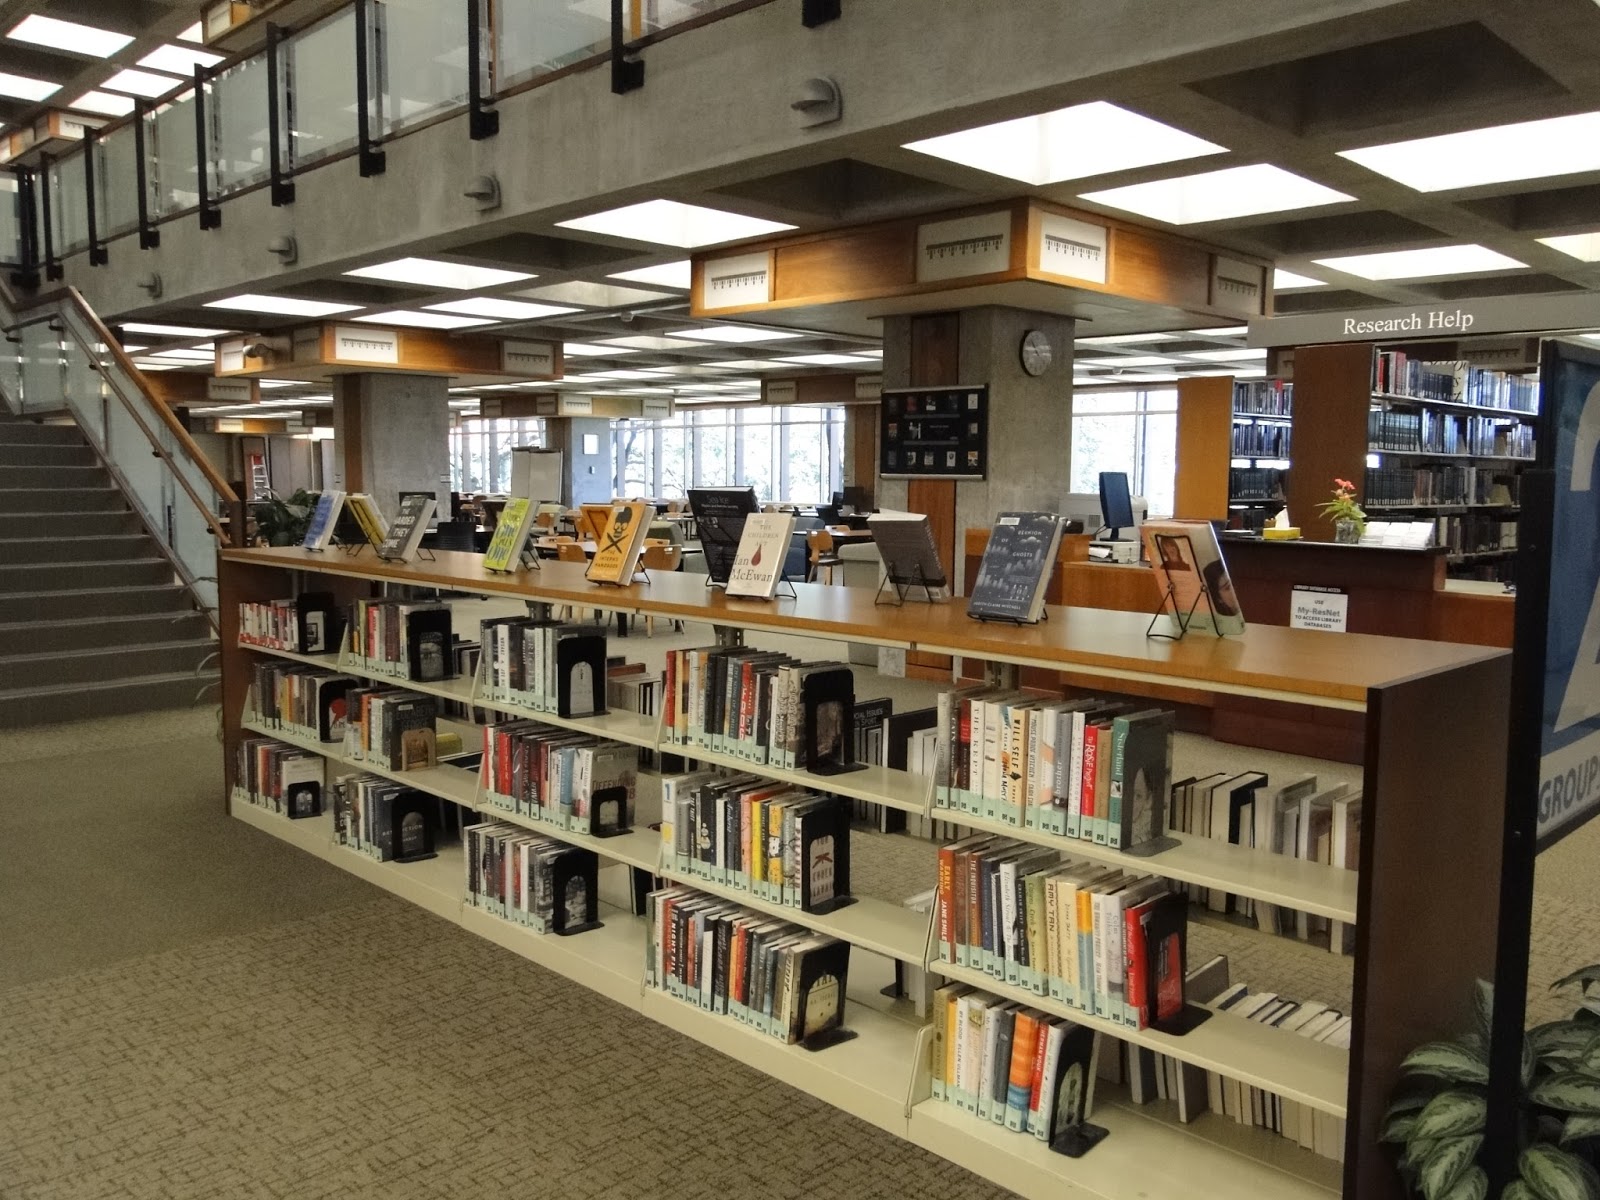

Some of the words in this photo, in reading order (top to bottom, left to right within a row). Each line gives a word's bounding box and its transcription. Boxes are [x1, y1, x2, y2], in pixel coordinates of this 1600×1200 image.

[1343, 313, 1422, 334] Research
[1428, 310, 1474, 331] Help
[393, 529, 409, 537] THEY
[734, 554, 749, 566] Ian
[731, 568, 773, 583] McEwan
[1297, 606, 1341, 617] My-ResNet
[1304, 621, 1332, 629] DATABASES
[1013, 719, 1021, 742] WILL
[1012, 746, 1020, 769] SELF
[1085, 743, 1096, 768] ROSIE
[1115, 732, 1125, 776] Sisterland
[1054, 761, 1063, 795] brother
[1538, 755, 1600, 824] GROUP
[943, 865, 951, 891] EARLY
[1038, 1029, 1046, 1054] HERMAN
